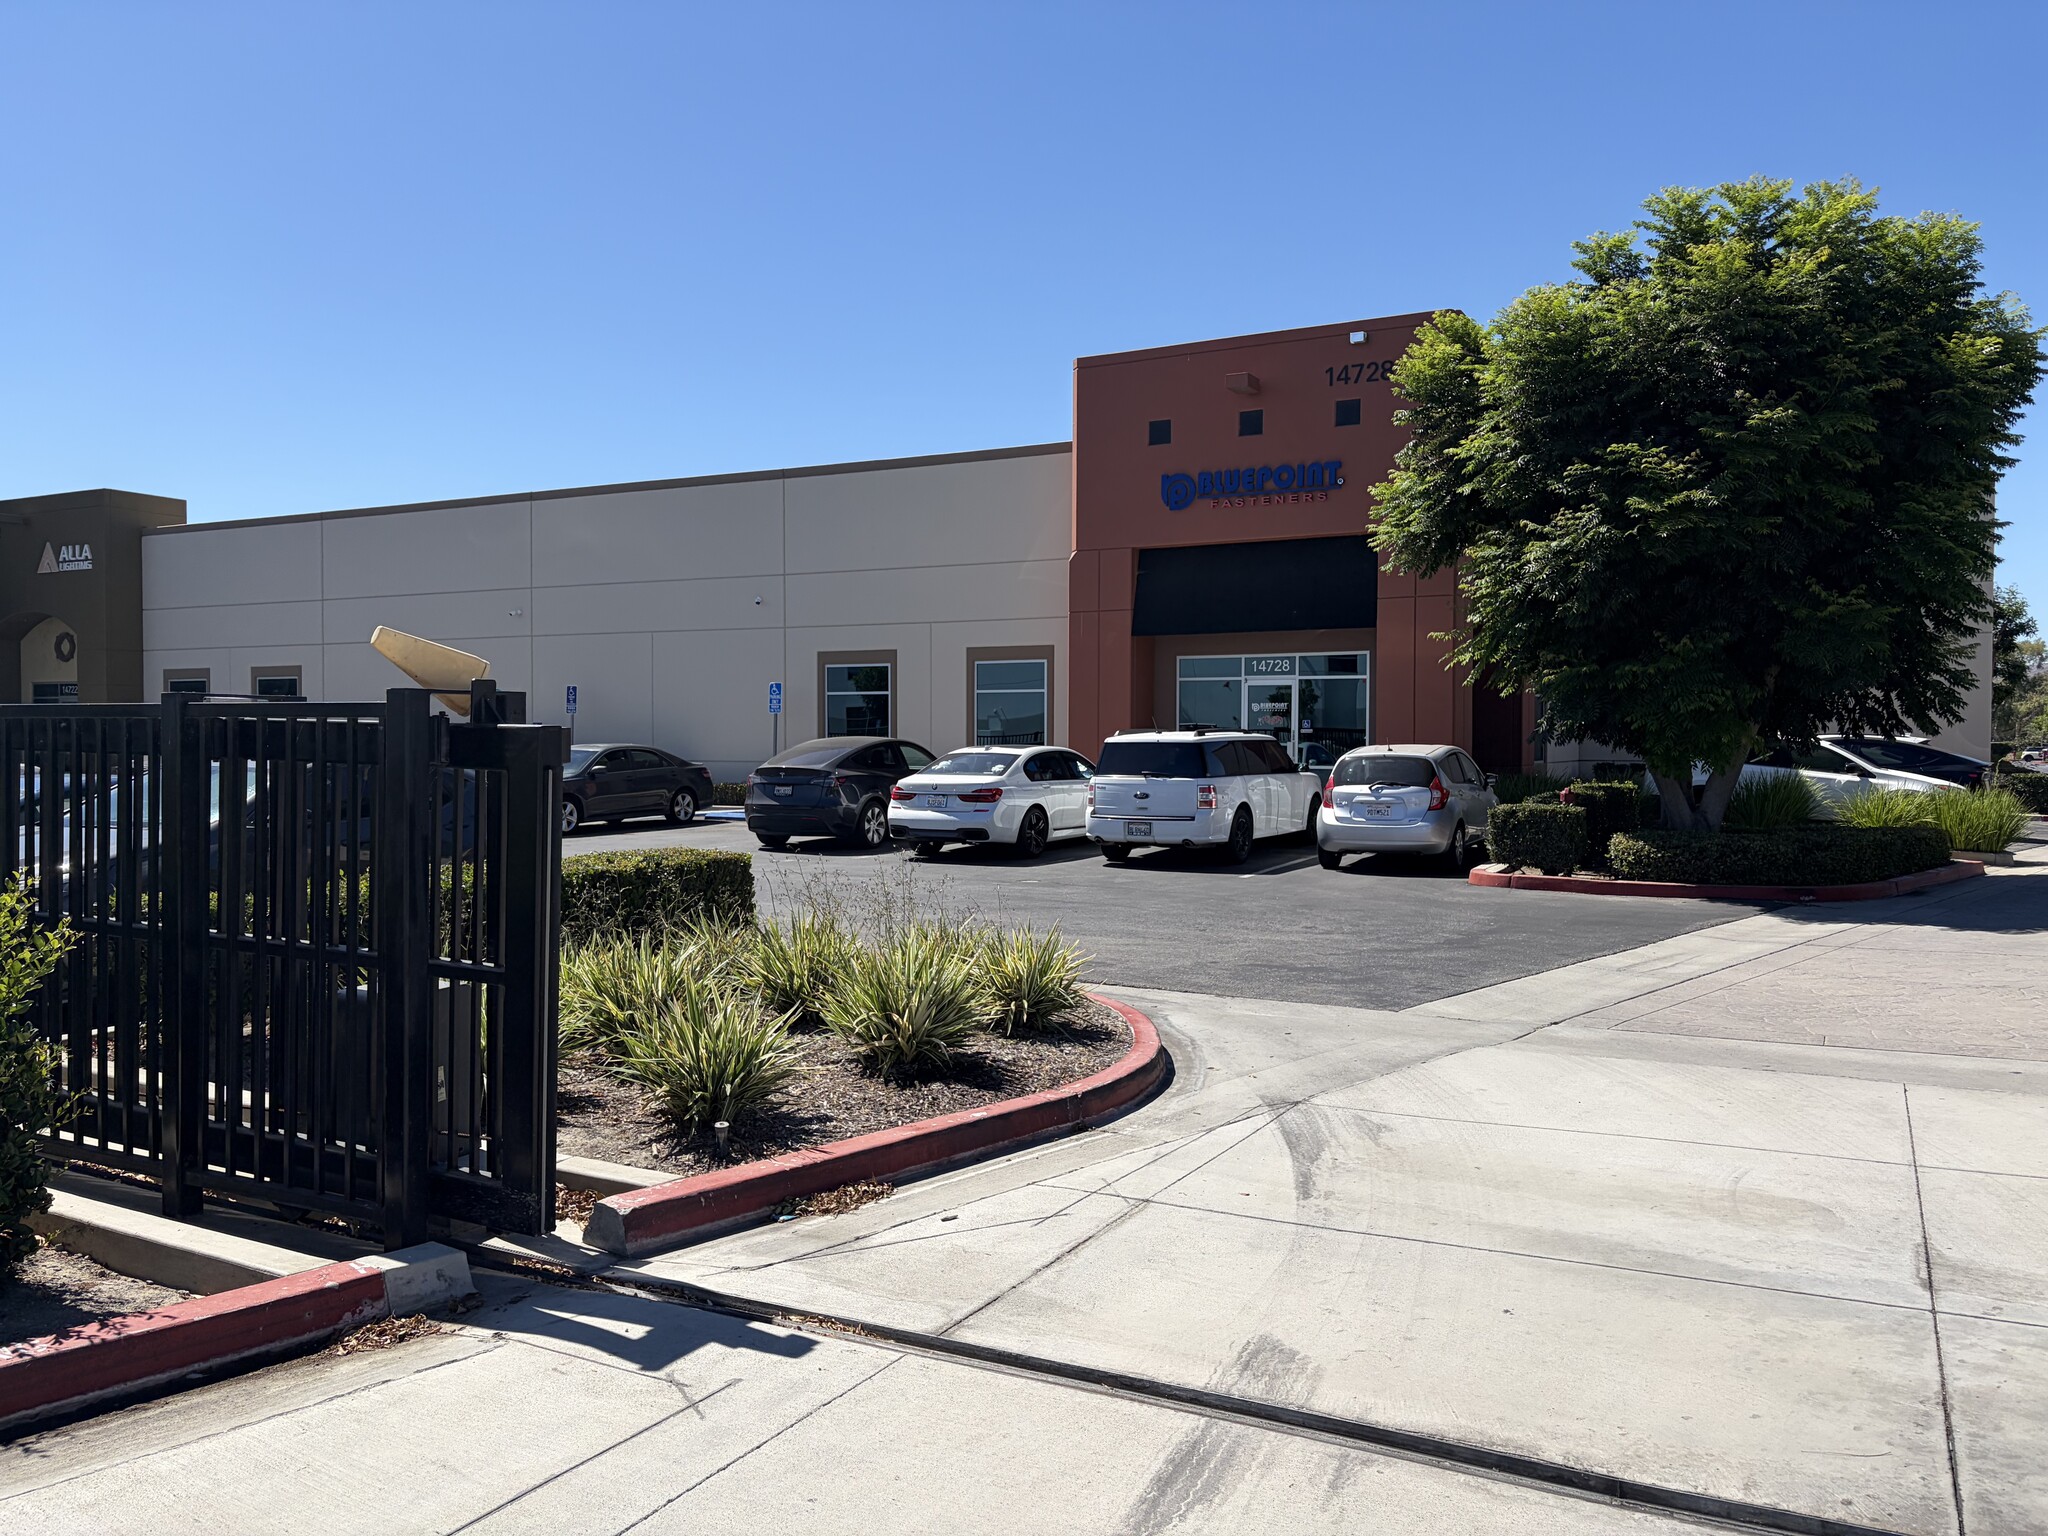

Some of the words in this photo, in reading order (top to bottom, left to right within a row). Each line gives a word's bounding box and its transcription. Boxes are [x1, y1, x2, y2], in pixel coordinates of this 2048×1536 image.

[1210, 492, 1328, 509] FASTENERS
[59, 544, 93, 561] ALLA
[59, 561, 93, 571] LIGHTING
[1251, 659, 1290, 672] 14728
